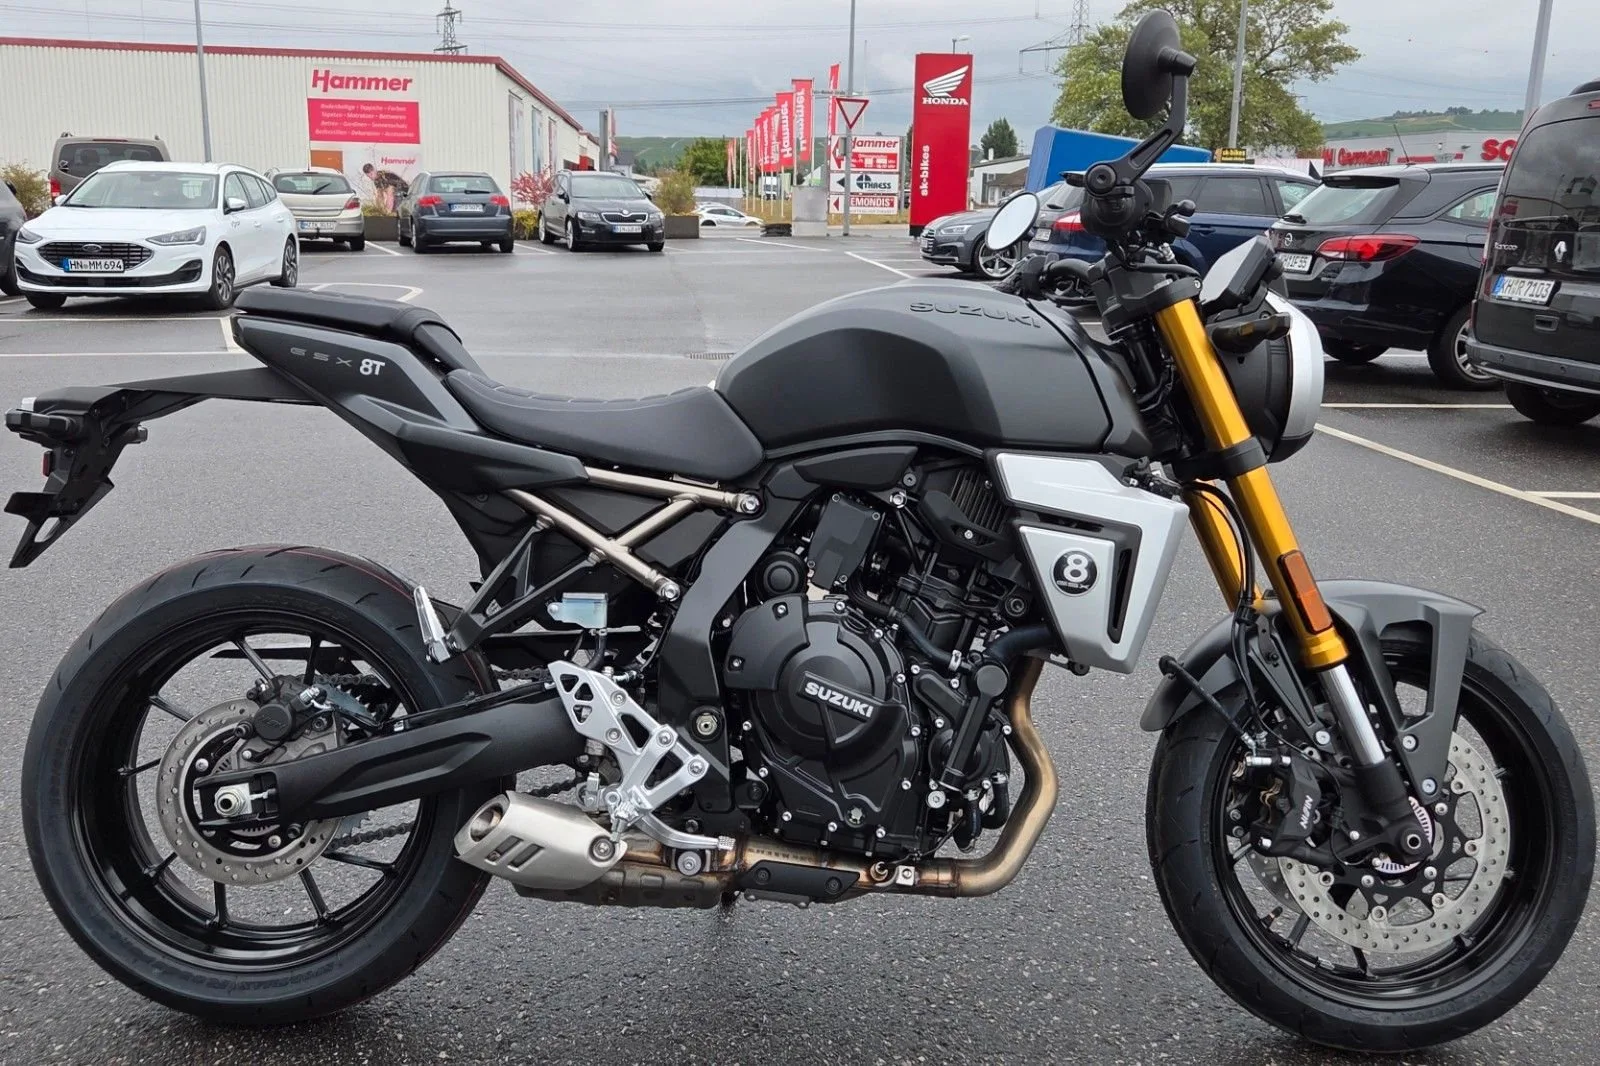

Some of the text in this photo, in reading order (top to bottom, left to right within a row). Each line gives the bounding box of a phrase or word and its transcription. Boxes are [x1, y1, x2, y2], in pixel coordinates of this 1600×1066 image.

[312, 69, 413, 92] Hammer
[922, 97, 969, 105] HONDA
[103, 261, 122, 270] 694
[1524, 281, 1552, 298] 7103
[910, 302, 1041, 328] SUZUKI
[359, 358, 386, 376] 8T
[1063, 554, 1089, 583] 8
[804, 681, 874, 718] SUZUKI
